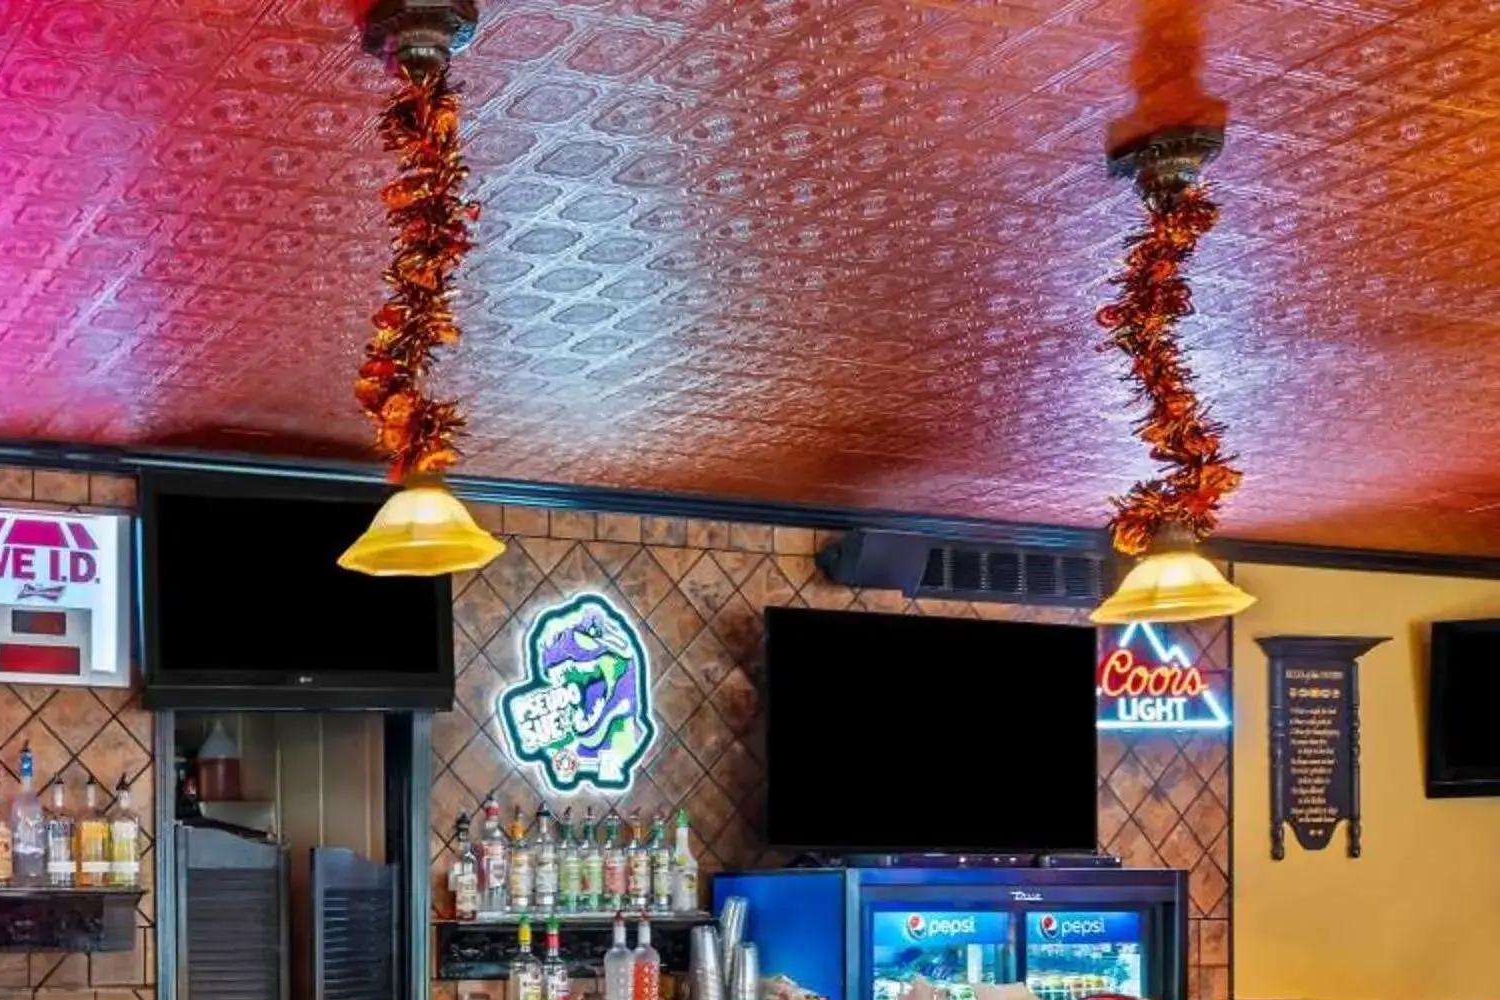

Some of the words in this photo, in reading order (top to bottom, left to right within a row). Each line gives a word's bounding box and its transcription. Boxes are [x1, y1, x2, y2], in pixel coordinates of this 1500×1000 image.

[49, 549, 101, 584] I.D.
[1102, 649, 1209, 697] Coors
[1117, 697, 1188, 721] LIGHT
[928, 916, 975, 937] pepsi
[1061, 917, 1105, 937] pepsi
